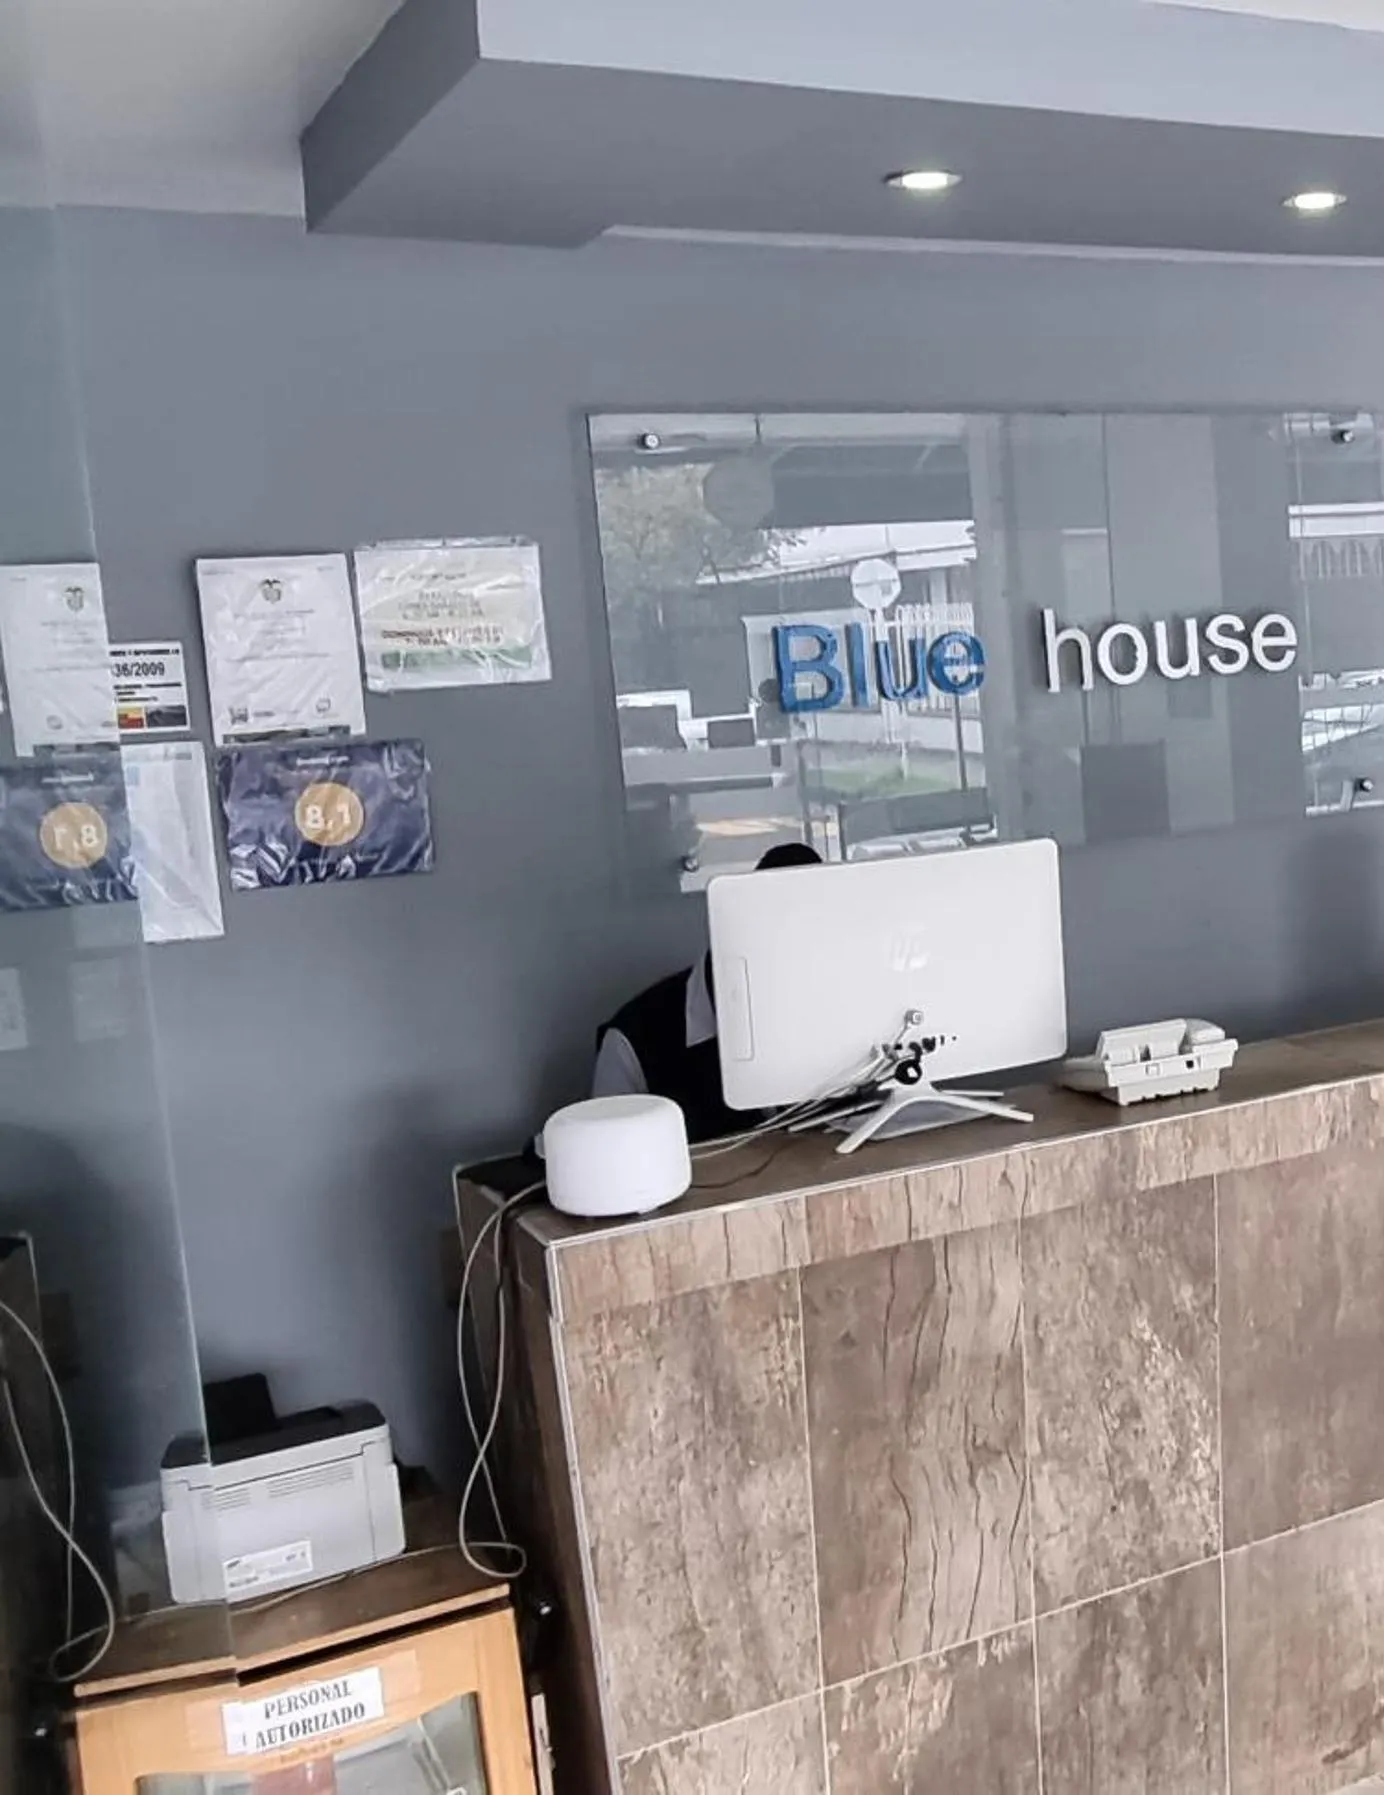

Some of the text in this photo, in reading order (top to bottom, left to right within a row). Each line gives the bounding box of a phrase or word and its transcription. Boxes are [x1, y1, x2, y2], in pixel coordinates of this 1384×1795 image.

[772, 608, 1299, 714] Blue house
[264, 1680, 352, 1720] PERSONAL
[255, 1702, 366, 1748] AUTORIZADO
